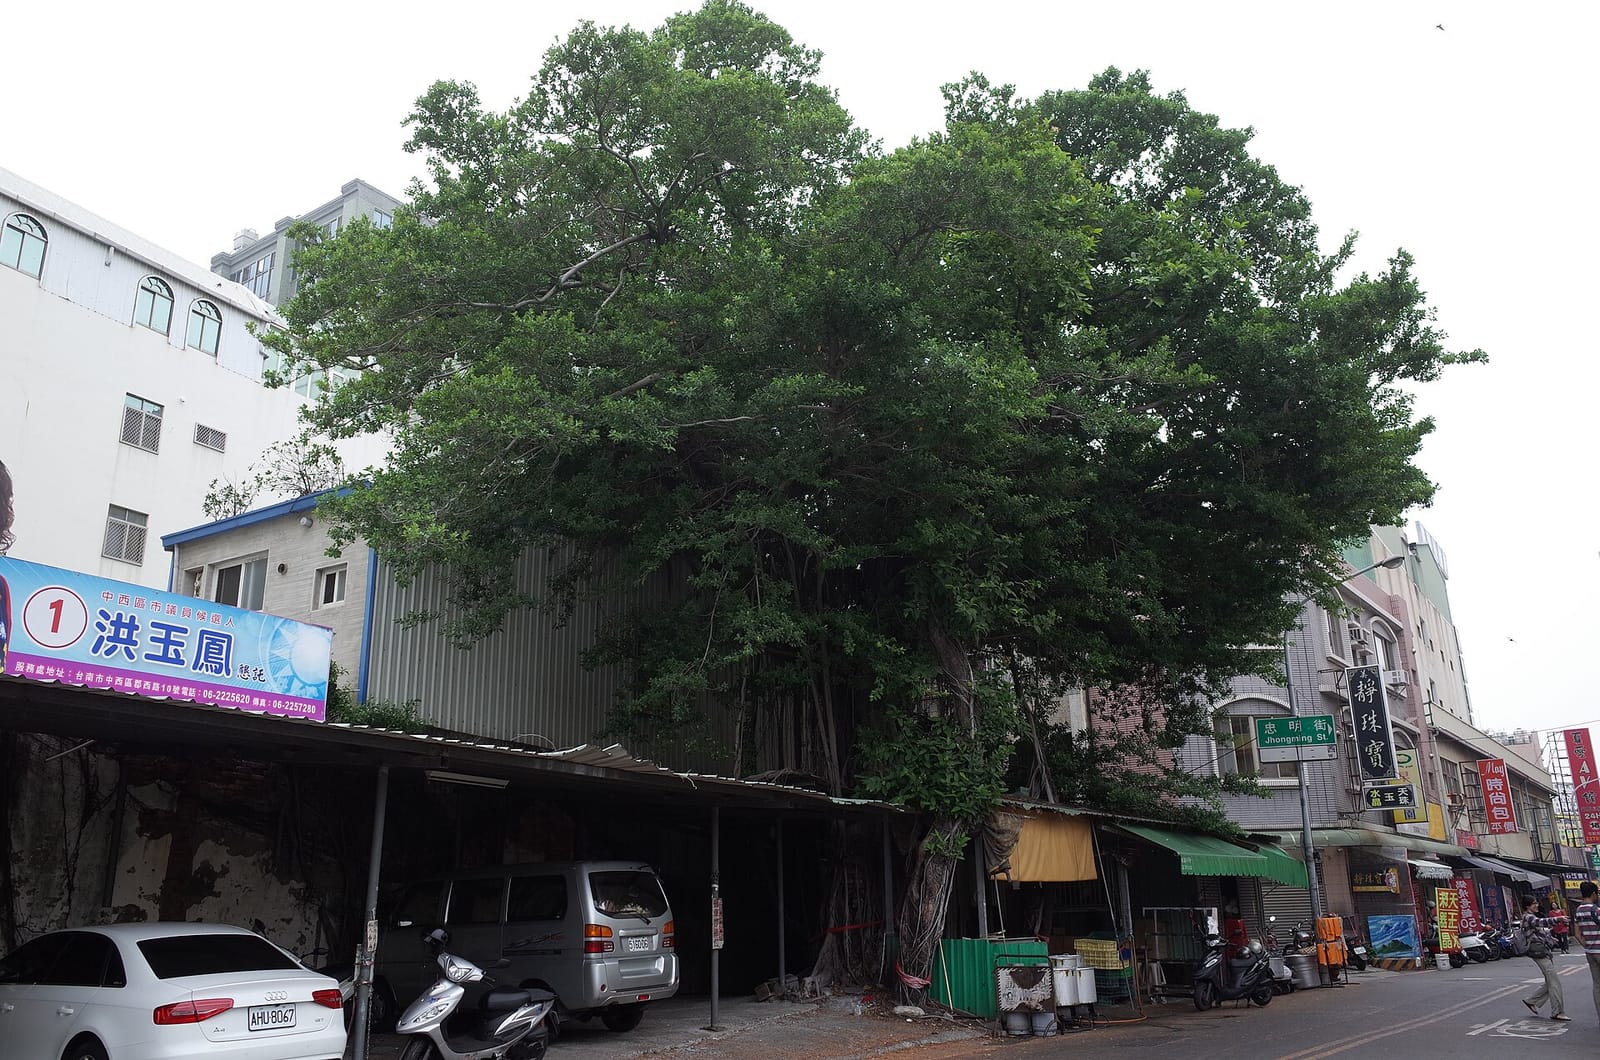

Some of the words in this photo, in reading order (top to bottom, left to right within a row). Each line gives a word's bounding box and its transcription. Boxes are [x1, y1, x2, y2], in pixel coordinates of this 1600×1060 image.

[49, 598, 65, 634] 1
[101, 590, 236, 628] 中西區市議員候選人
[90, 607, 234, 677] 洪玉鳳
[236, 663, 266, 683] 懇託
[1264, 719, 1327, 735] 忠明街
[1265, 735, 1313, 744] Jhongming
[1317, 733, 1329, 741] St.
[1370, 789, 1382, 807] 水晶
[1397, 787, 1410, 805] 天珠
[1485, 777, 1510, 820] 時尚包
